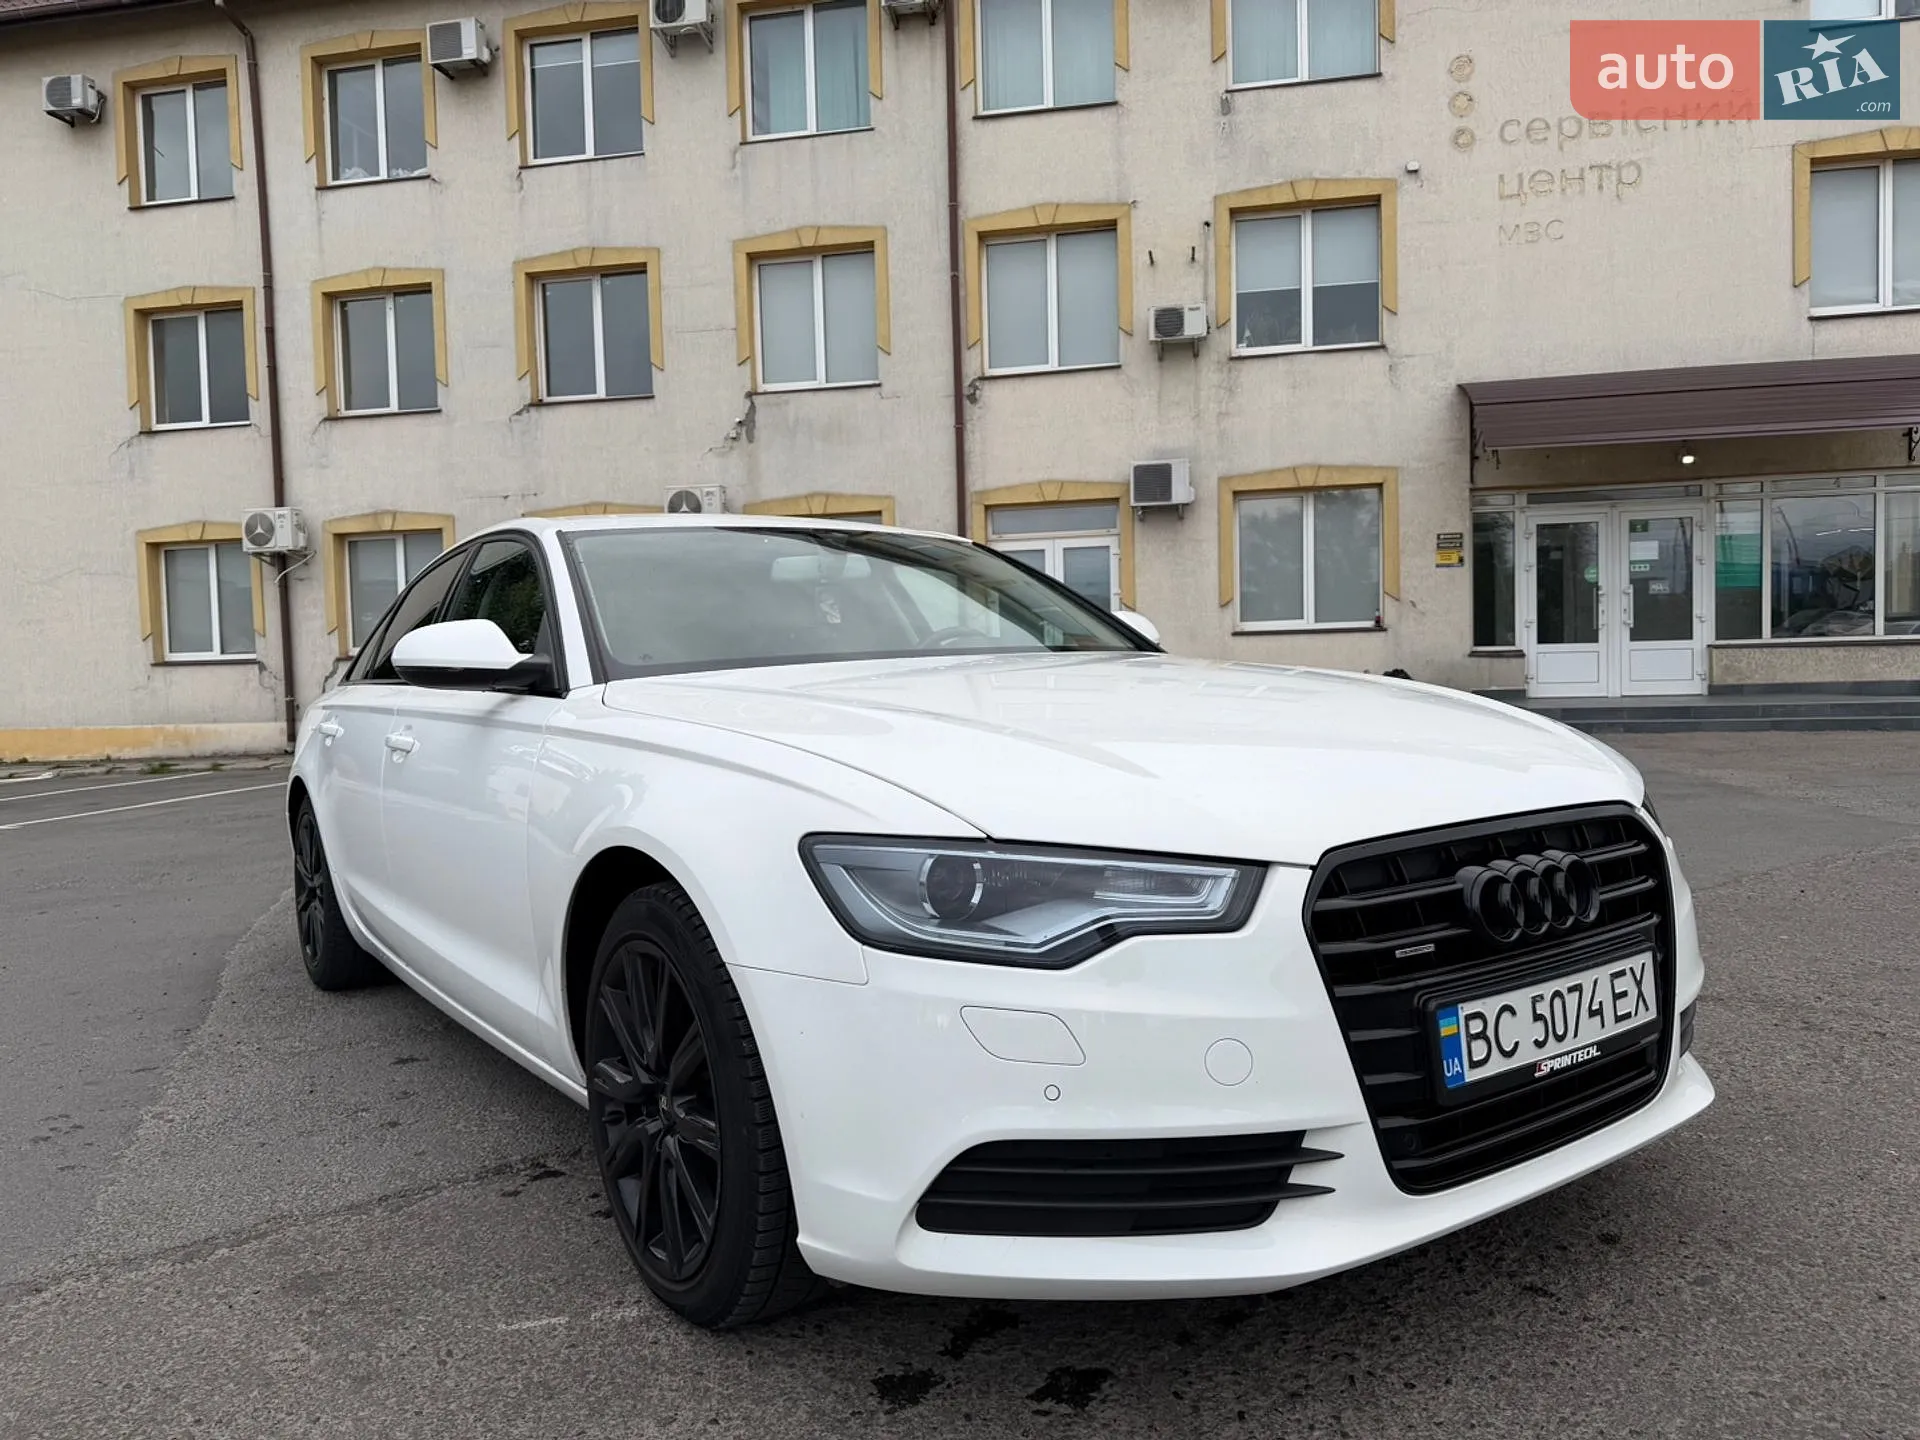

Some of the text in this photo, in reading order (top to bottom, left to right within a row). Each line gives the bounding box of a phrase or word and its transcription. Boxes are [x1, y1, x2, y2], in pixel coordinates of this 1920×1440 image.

[1498, 159, 1643, 205] центр
[1463, 960, 1650, 1070] BC 5074 EX
[1443, 1058, 1463, 1078] UA
